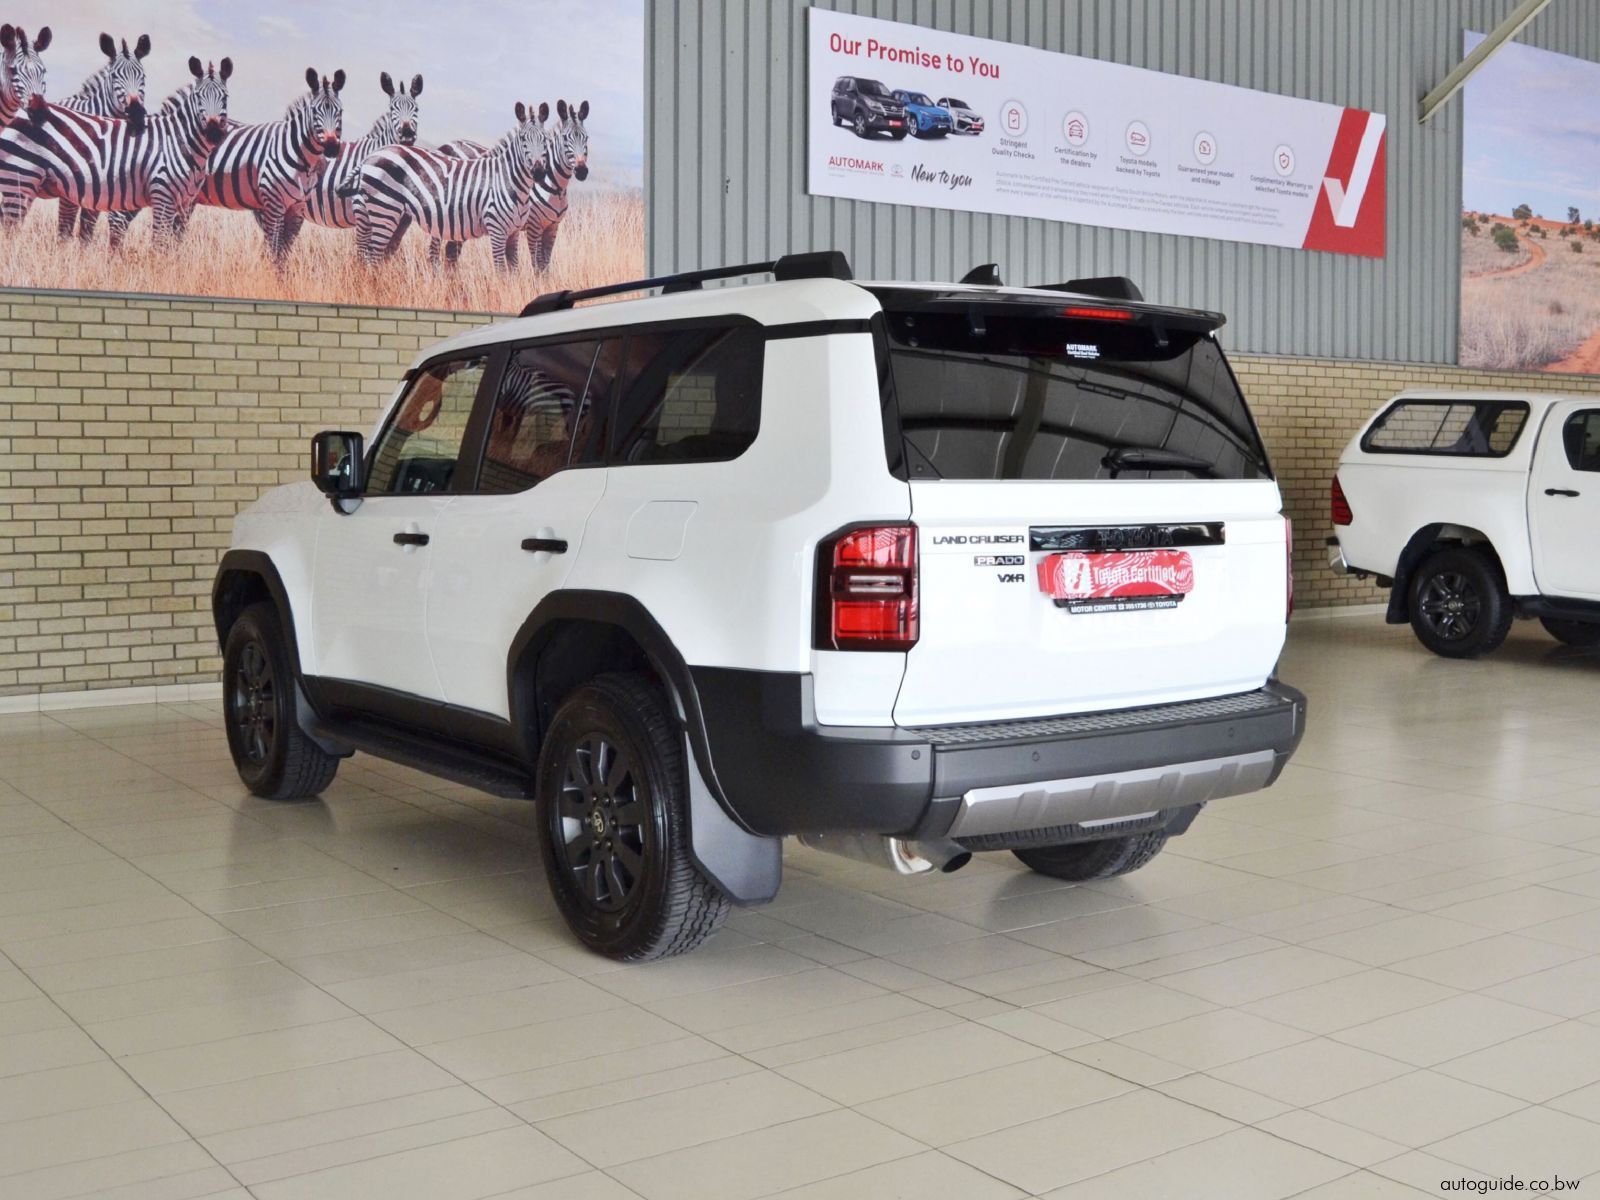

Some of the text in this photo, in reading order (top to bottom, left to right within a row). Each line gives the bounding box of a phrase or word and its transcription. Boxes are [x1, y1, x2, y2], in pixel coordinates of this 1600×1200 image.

[830, 33, 1000, 79] Our Promise to You
[1000, 138, 1028, 149] Stringent
[992, 148, 1035, 160] Quality Checks
[1054, 146, 1098, 160] Certification by
[828, 156, 884, 172] AUTOMARK
[1070, 158, 1091, 168] dealers
[1120, 155, 1157, 168] Toyota models
[1116, 166, 1160, 178] backed by Toyota
[1177, 164, 1206, 175] Guaranteed
[911, 163, 973, 191] New to you
[1275, 187, 1291, 196] Toyota
[933, 535, 1025, 545] LAND CRUISER
[1099, 528, 1174, 546] TOYOTA
[977, 556, 1023, 565] PRADO
[1093, 564, 1176, 585] Toyota Certified
[1070, 605, 1093, 613] MOTOR
[1093, 604, 1117, 612] CENTRE
[1155, 600, 1177, 608] TOYOTA
